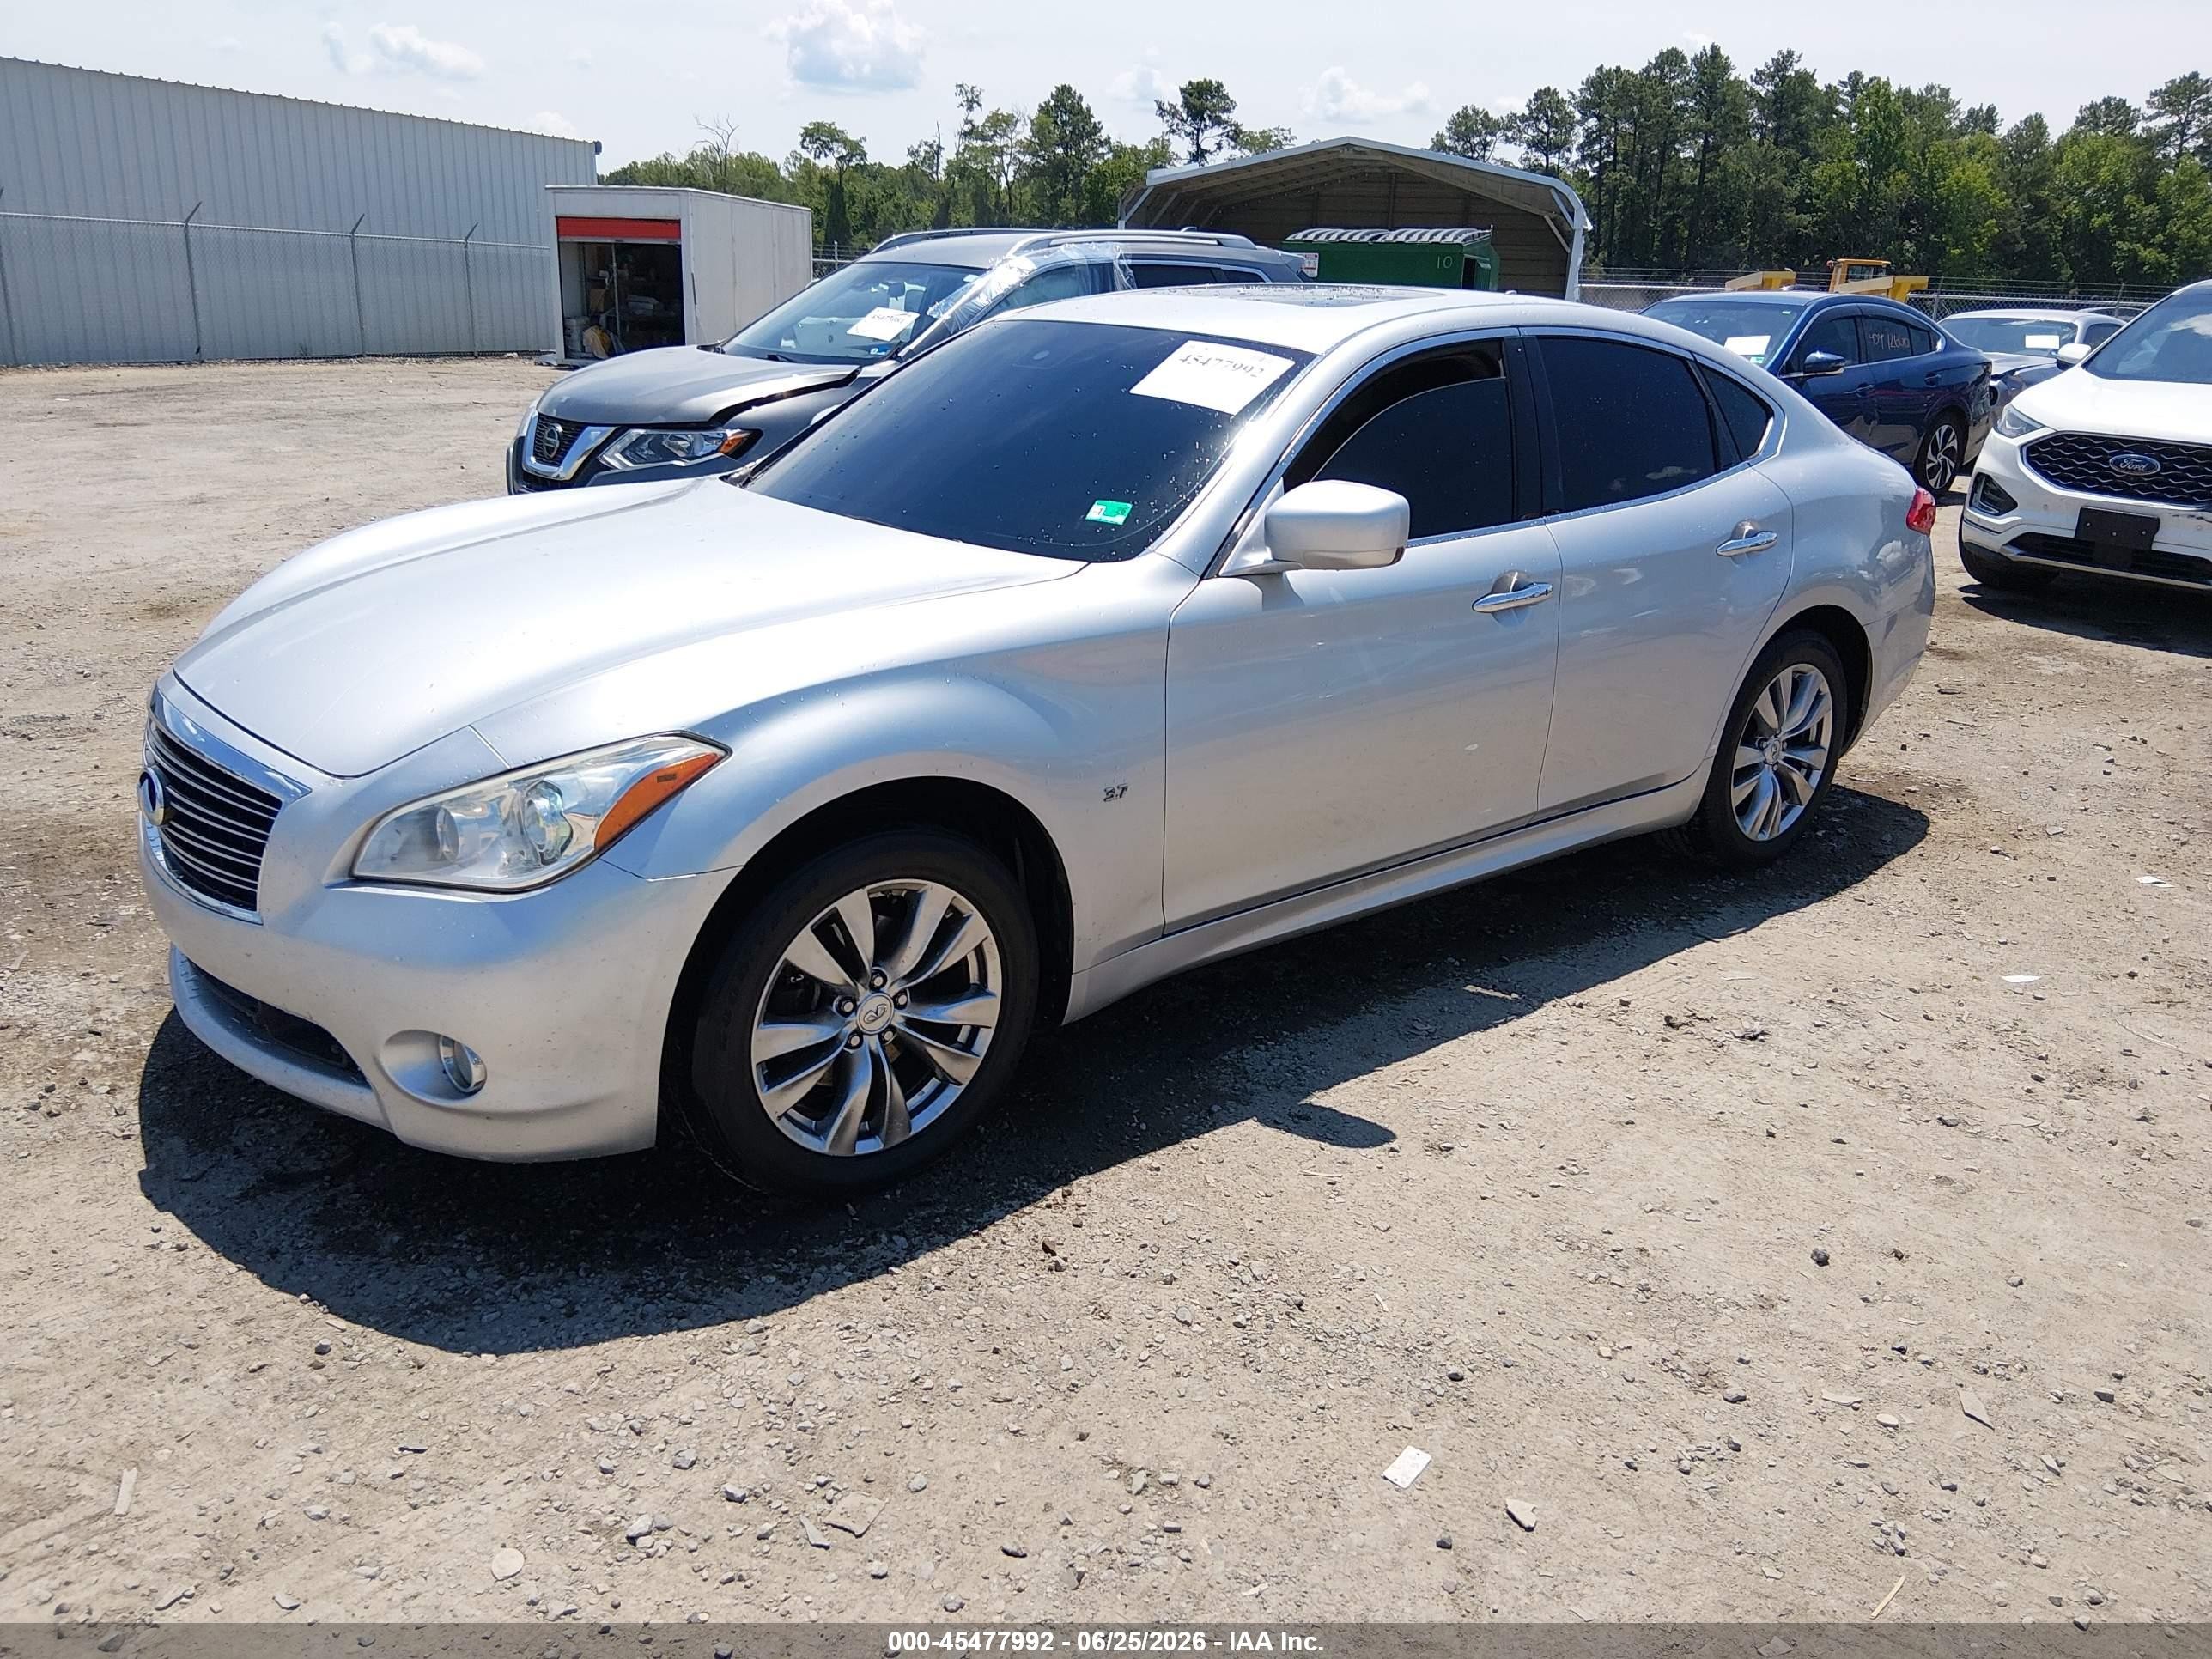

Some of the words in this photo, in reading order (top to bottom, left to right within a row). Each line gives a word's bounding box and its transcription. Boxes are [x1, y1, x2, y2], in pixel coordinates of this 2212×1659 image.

[1437, 255, 1453, 269] 10
[1179, 354, 1265, 378] 45477992
[2119, 458, 2149, 471] Ford
